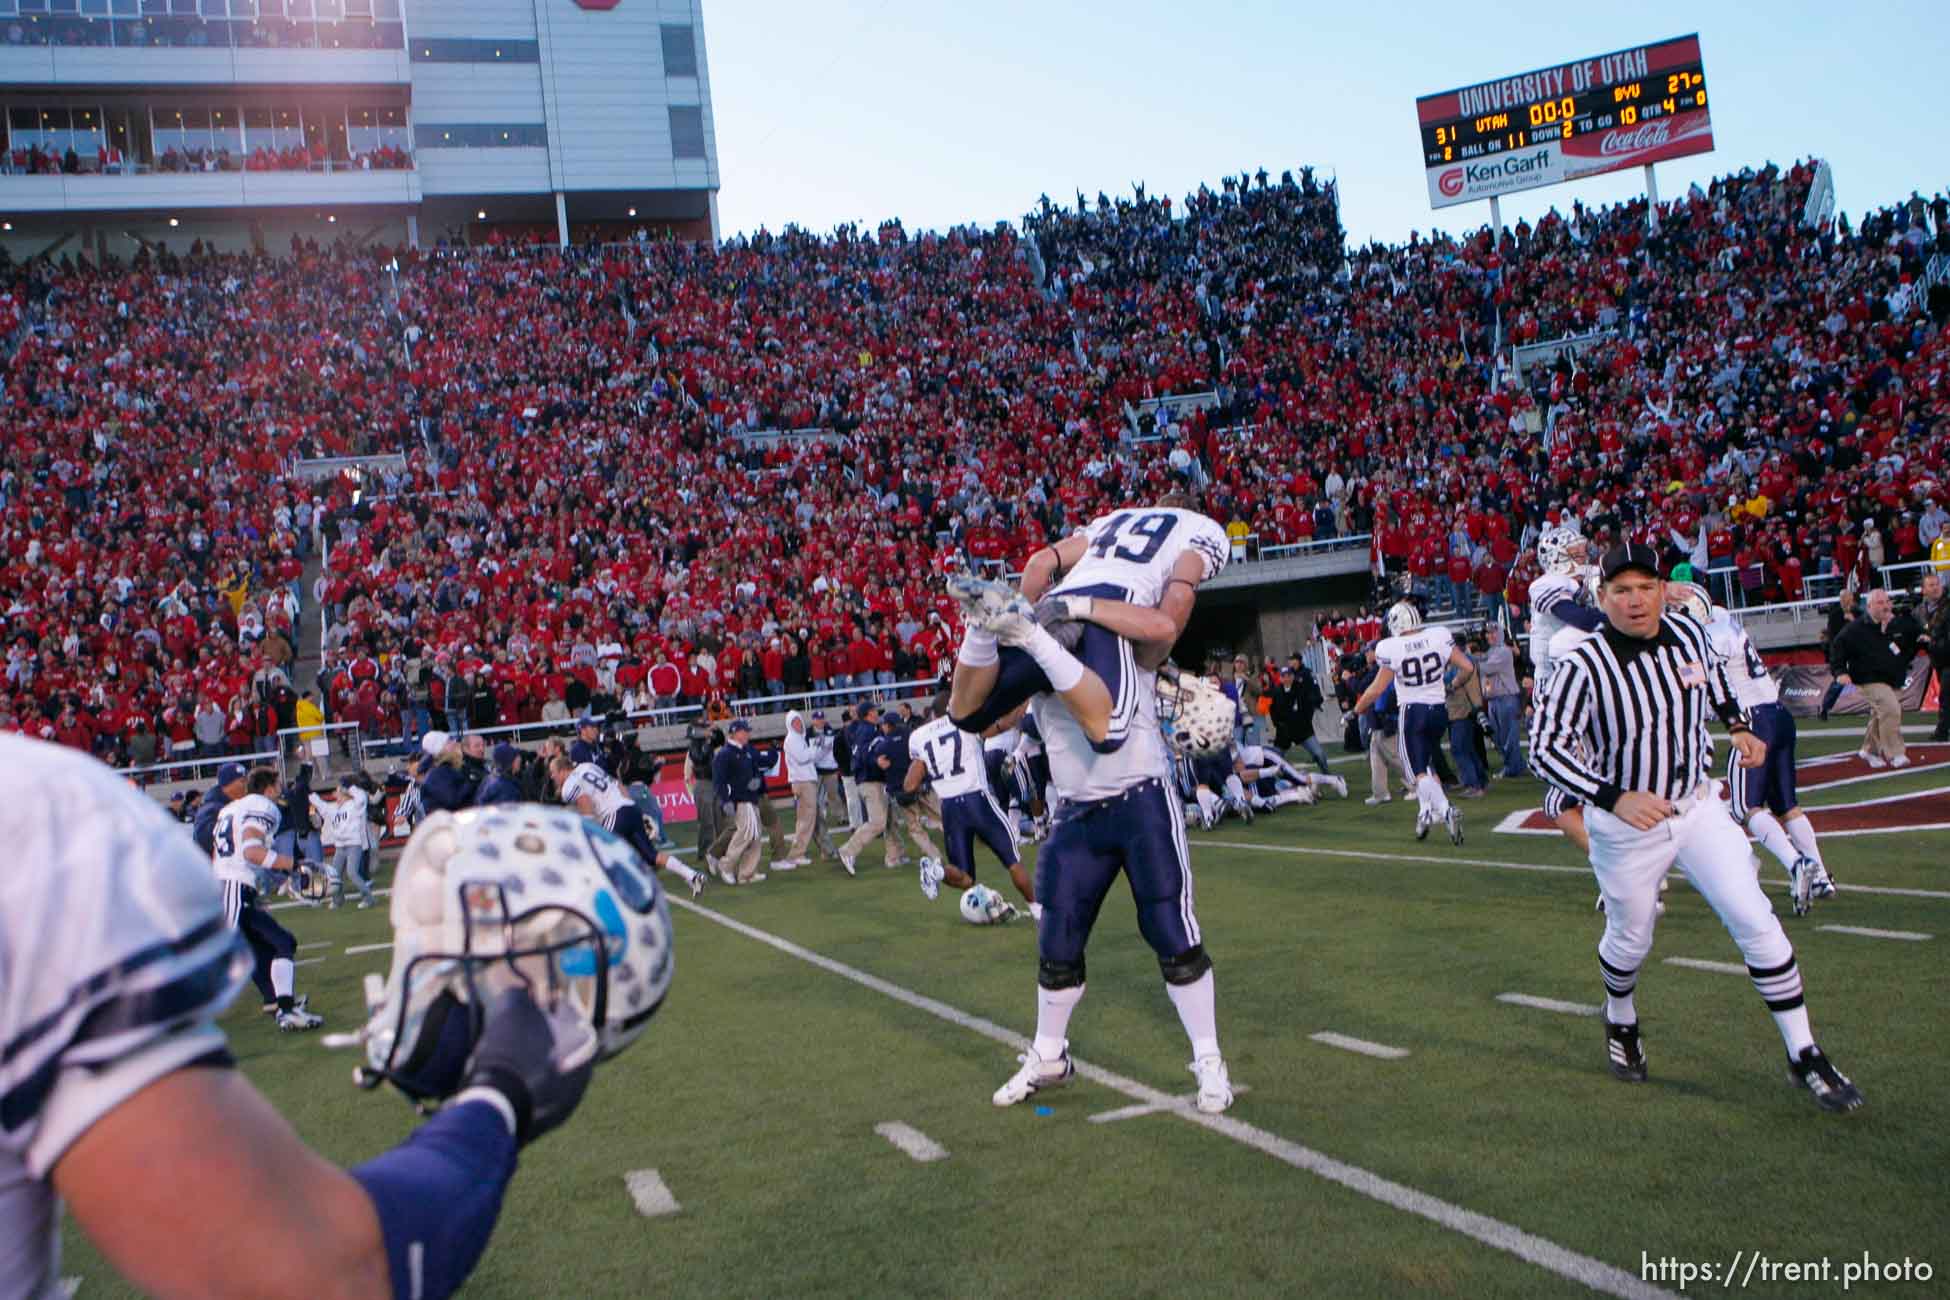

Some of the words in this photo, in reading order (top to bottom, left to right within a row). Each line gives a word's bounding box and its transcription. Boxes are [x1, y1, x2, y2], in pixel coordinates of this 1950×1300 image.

[1459, 67, 1565, 117] UNIVERSITY
[1571, 60, 1595, 92] OF
[1600, 48, 1649, 85] UTAH
[1614, 83, 1641, 103] BYU
[1696, 90, 1706, 106] 0
[1620, 105, 1637, 125] 10
[1663, 97, 1675, 114] 4
[1475, 112, 1508, 133] UTAH
[1562, 119, 1573, 139] 2
[1579, 119, 1593, 132] TO
[1597, 114, 1613, 127] GO
[1435, 125, 1456, 145] 31
[1531, 126, 1561, 143] DOWN
[1600, 119, 1672, 155] Coca-Cola
[1461, 143, 1486, 158] BALL
[1488, 139, 1502, 151] ON
[1466, 163, 1503, 183] Ken
[1503, 150, 1550, 175] Garff
[1089, 512, 1179, 564] 49
[1401, 651, 1442, 687] 92
[924, 728, 966, 781] 17
